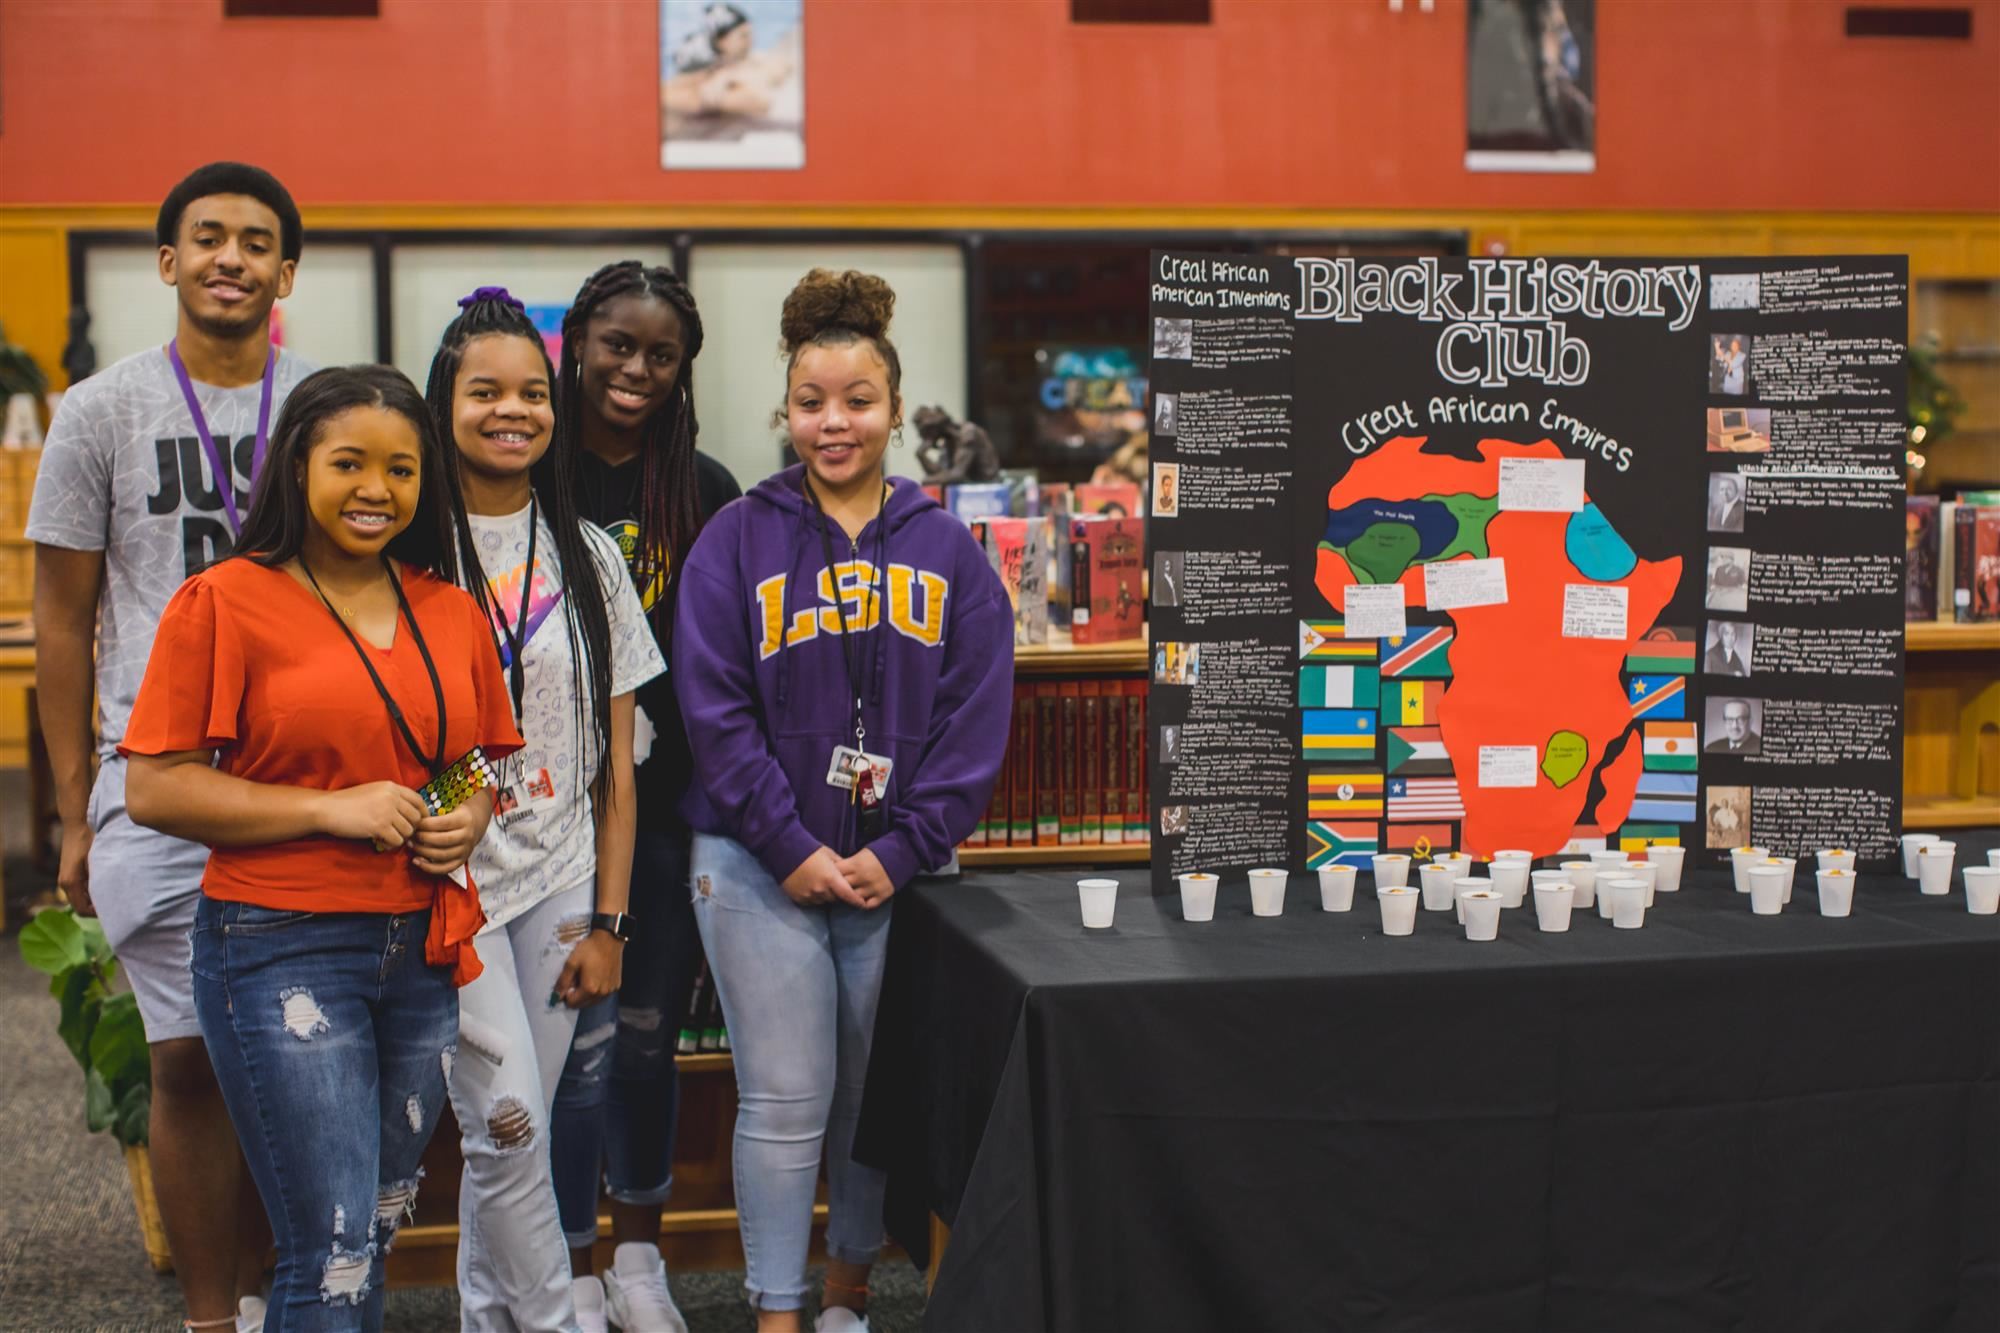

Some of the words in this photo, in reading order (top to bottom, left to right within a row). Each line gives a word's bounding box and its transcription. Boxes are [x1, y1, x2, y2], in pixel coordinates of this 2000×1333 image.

[1152, 284, 1214, 306] American
[1217, 288, 1291, 311] Inventions
[1160, 254, 1206, 283] Great
[1212, 262, 1269, 284] African
[1294, 257, 1466, 322] Black
[1468, 258, 1701, 331] History
[1437, 322, 1590, 387] Club
[1341, 401, 1418, 454] Great
[1428, 395, 1529, 423] African
[1539, 399, 1634, 472] Empires
[147, 435, 269, 515] JUS
[182, 516, 237, 577] D
[755, 560, 949, 661] LSU
